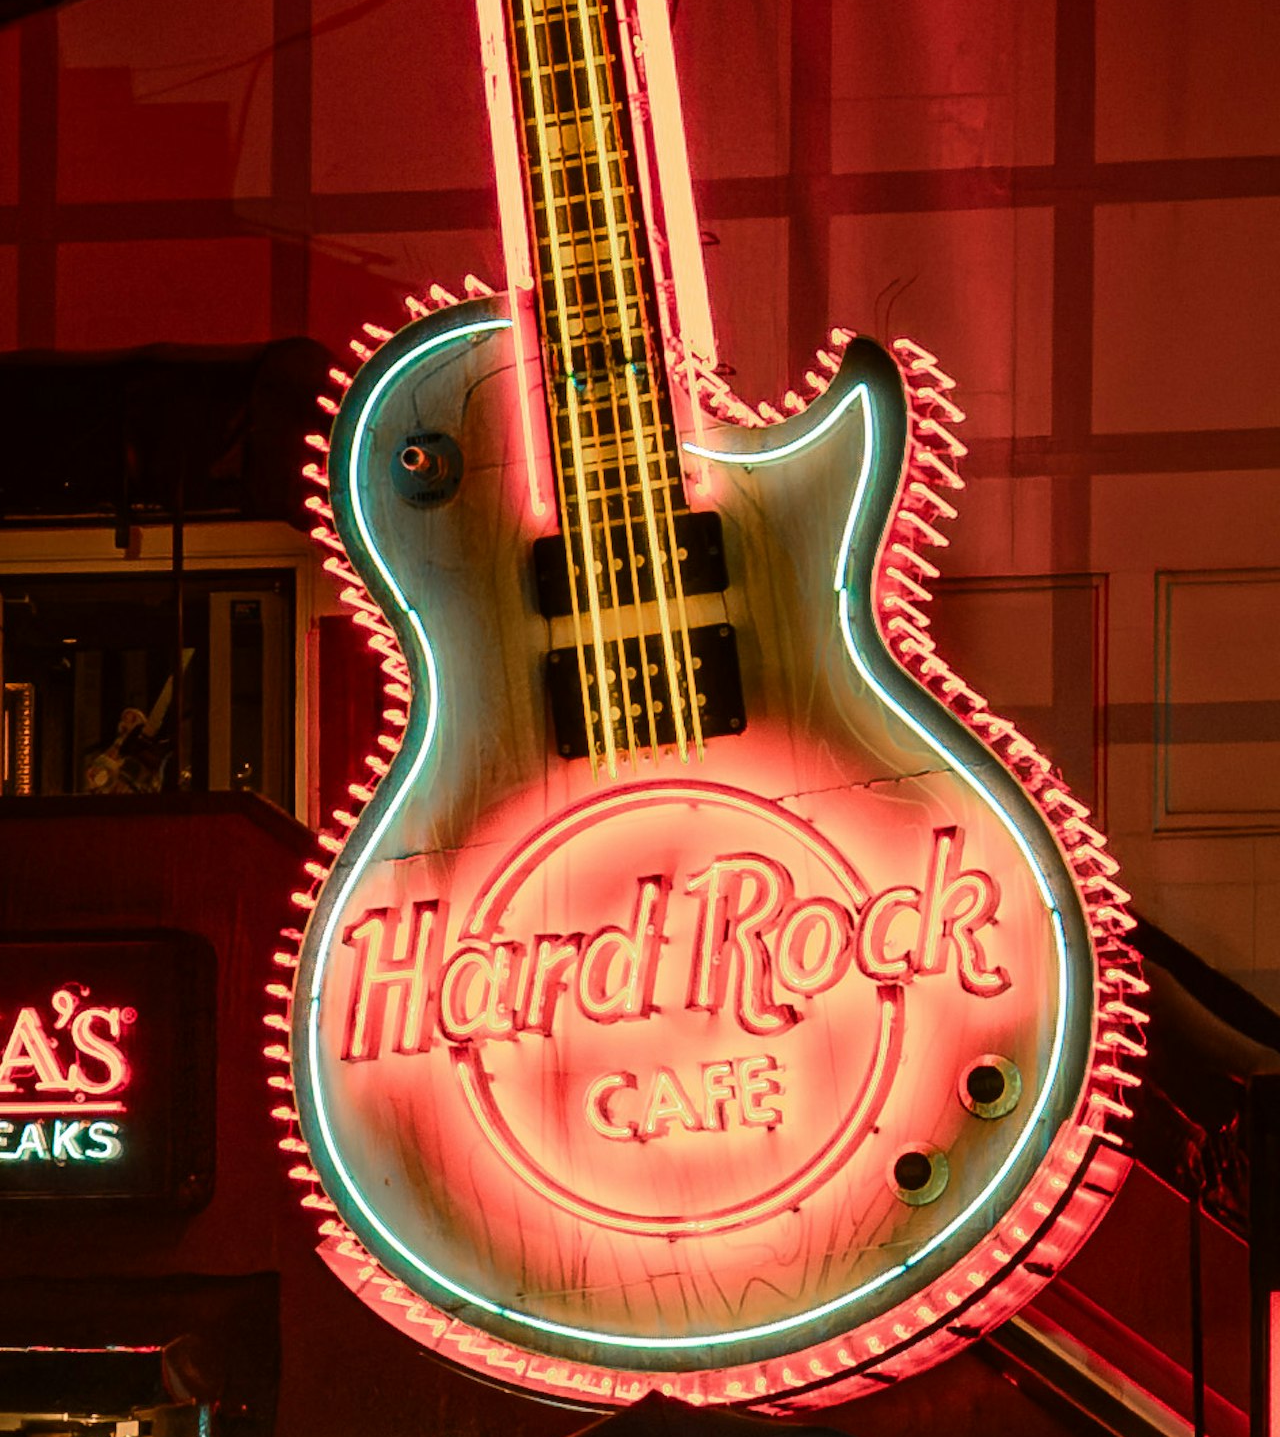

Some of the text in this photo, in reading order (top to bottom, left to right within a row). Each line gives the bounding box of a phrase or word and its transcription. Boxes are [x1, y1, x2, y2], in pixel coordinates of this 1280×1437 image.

[341, 825, 1013, 1063] Hard Rock
[583, 1054, 784, 1141] CAFE
